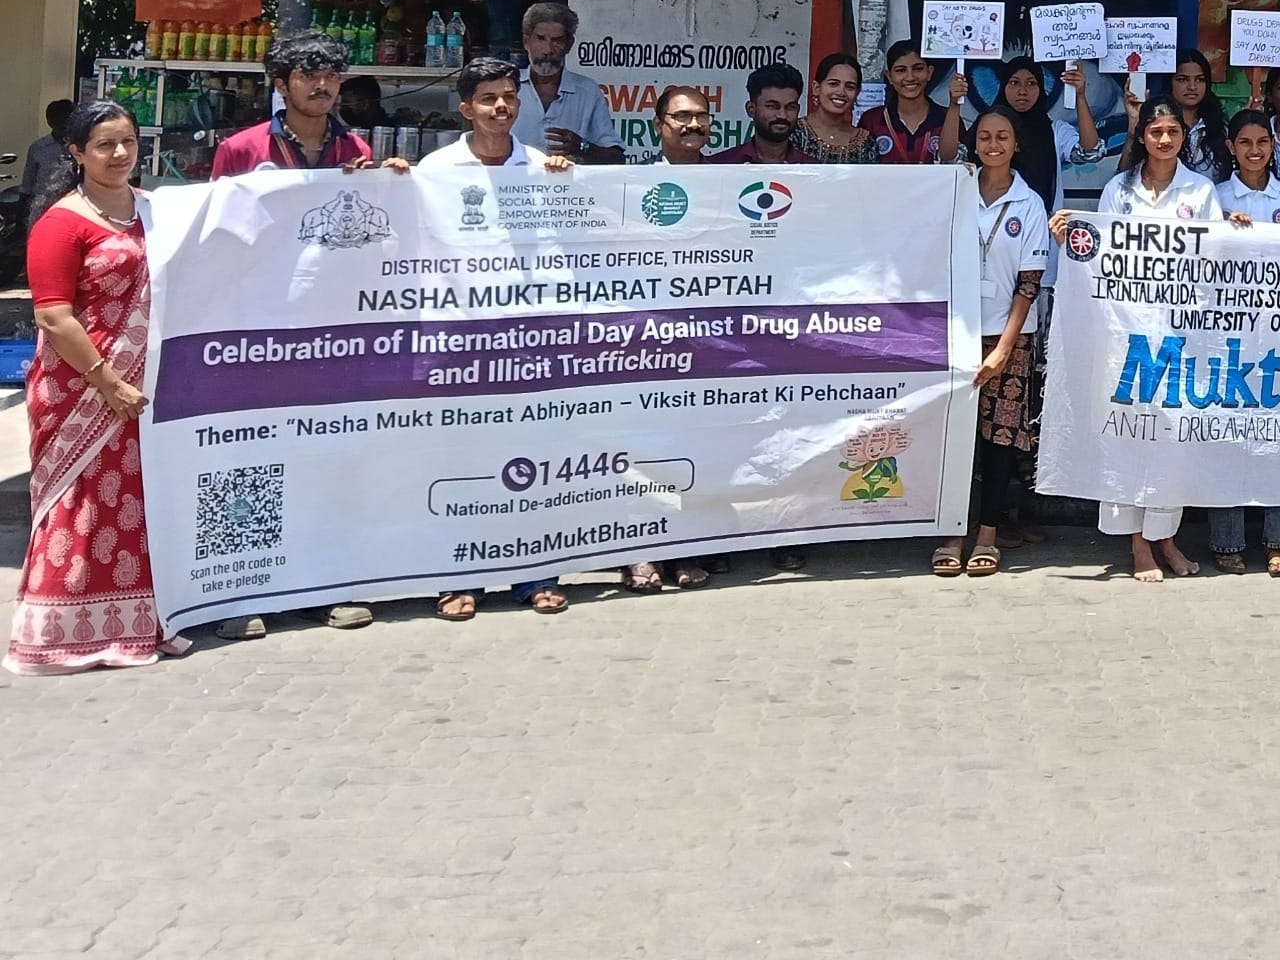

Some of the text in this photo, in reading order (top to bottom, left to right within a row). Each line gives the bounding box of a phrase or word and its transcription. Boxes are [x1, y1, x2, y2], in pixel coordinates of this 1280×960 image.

[1252, 42, 1266, 52] NO
[1270, 45, 1280, 53] TO
[498, 184, 569, 194] MINISTRY OF
[1111, 220, 1209, 255] CHRIST
[381, 249, 754, 276] DISTRICT SOCIAL JUSTICE OFFICE, THRISSUR
[357, 274, 773, 312] NASHA MUKT BHARAT SAPTAH
[1170, 309, 1260, 332] UNIVERSITY
[202, 312, 881, 366] Celebration of International Day Against Drug Abuse
[428, 347, 693, 386] and Illicit Trafficking
[195, 424, 278, 448] Theme:
[376, 410, 434, 431] Mukt
[441, 405, 514, 427] Bharat
[520, 399, 612, 423] Abhiyaan
[639, 391, 697, 410] Viksit
[703, 389, 769, 406] Bharat
[775, 386, 794, 403] Ki
[539, 451, 629, 486] 14446
[445, 482, 676, 517] National De-addiction Helpline
[453, 517, 668, 562] #NashaMuktBharat
